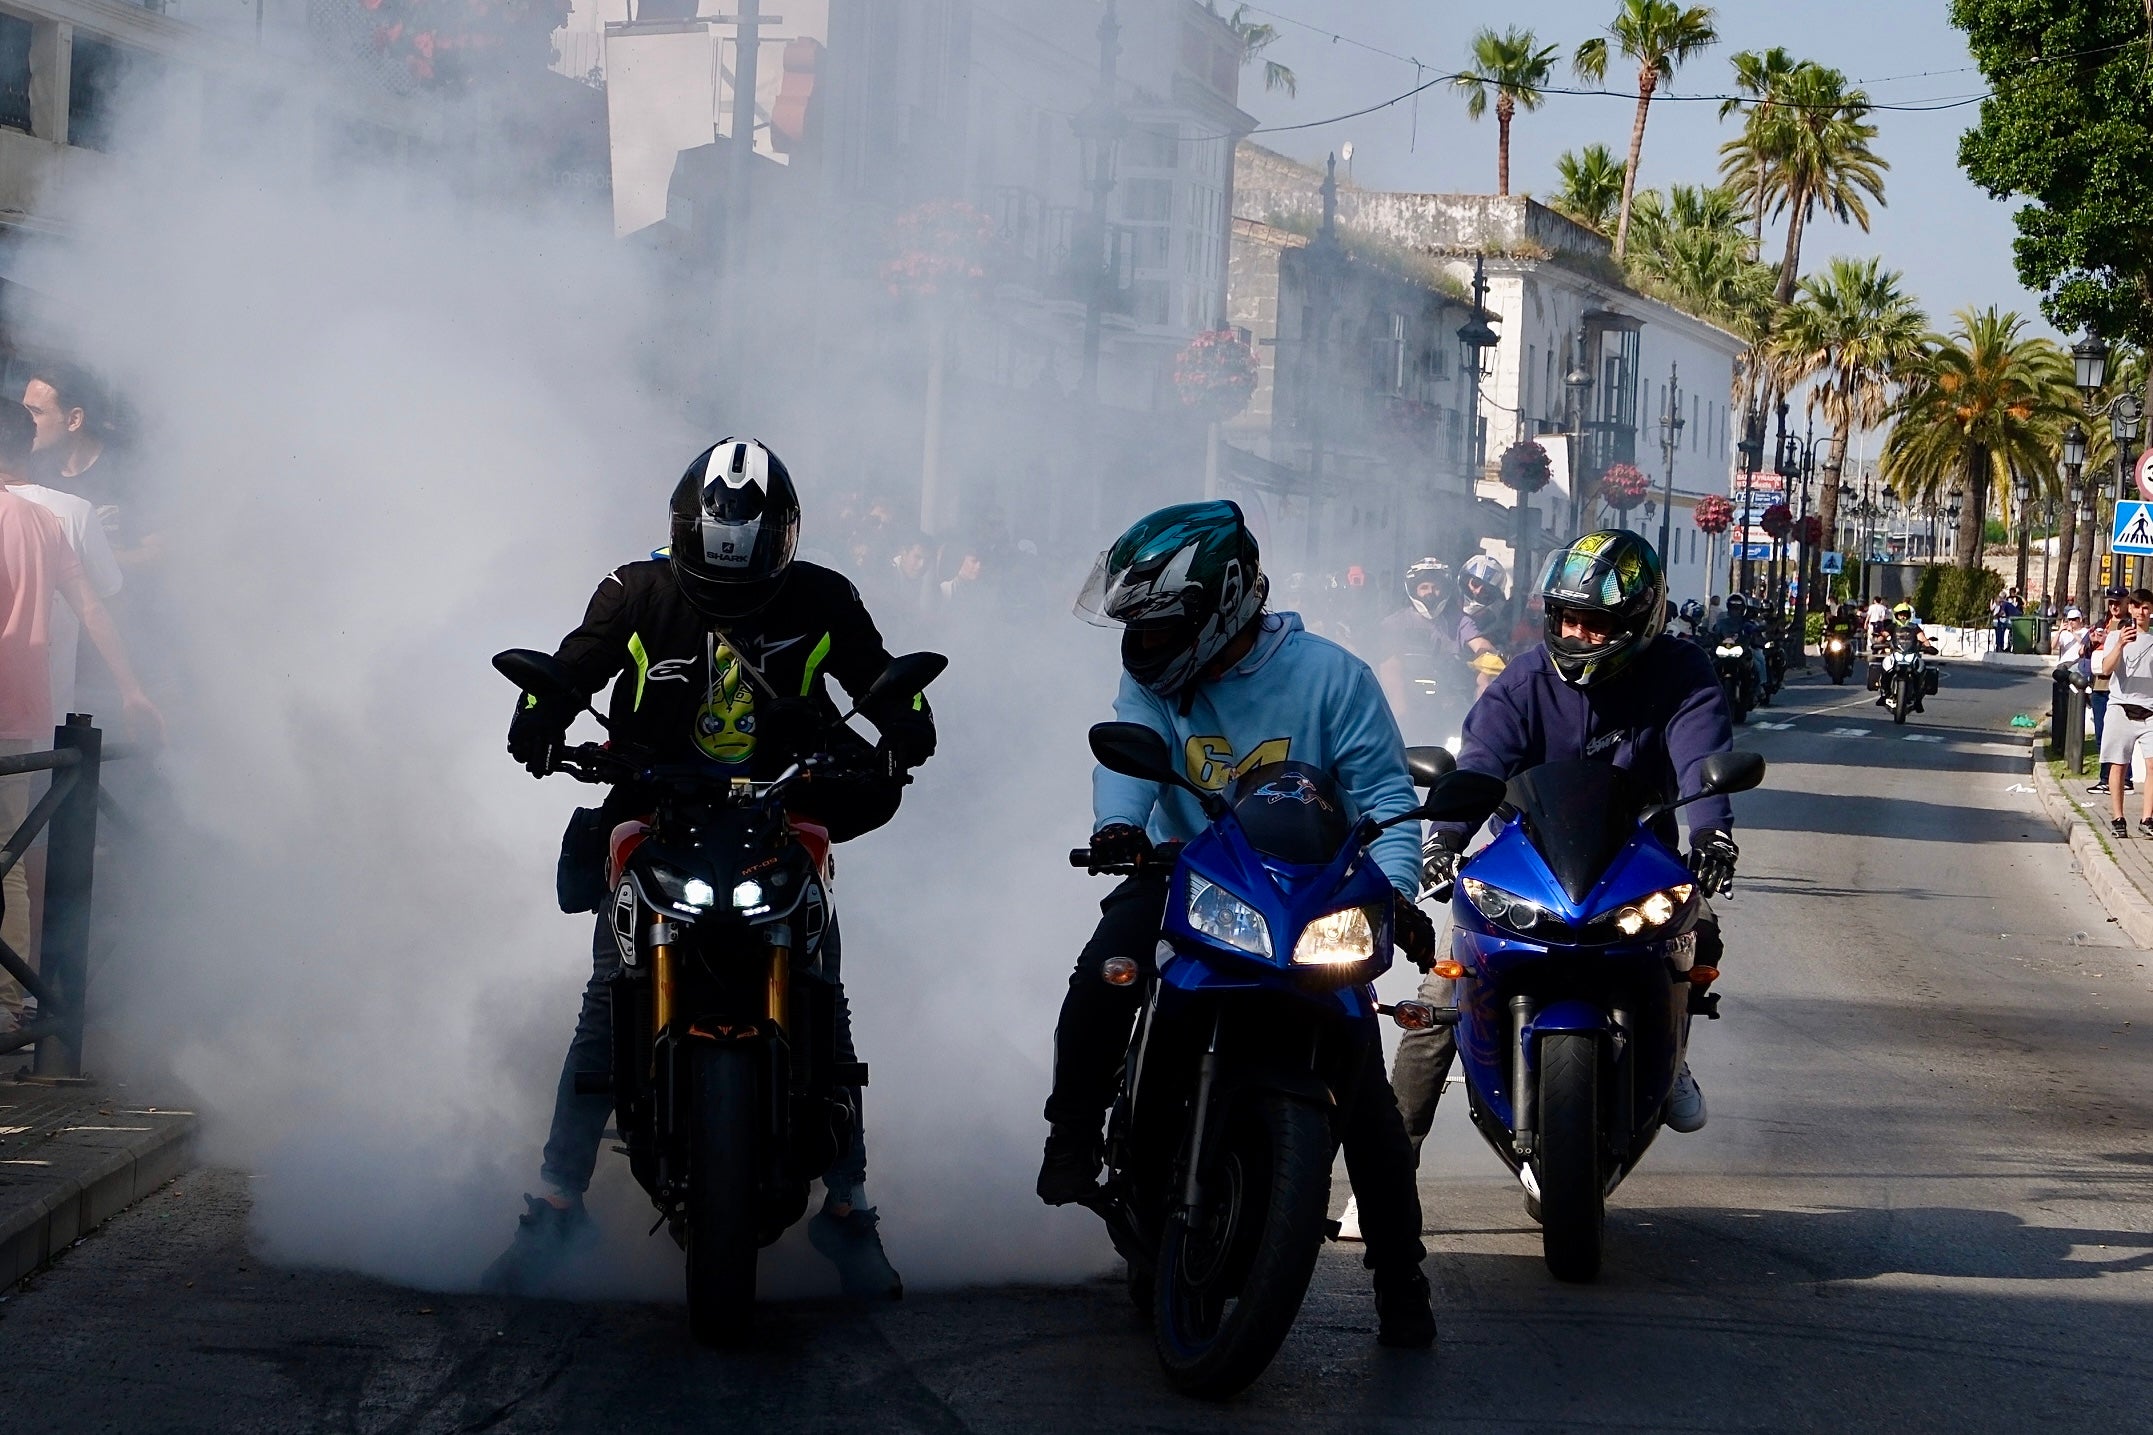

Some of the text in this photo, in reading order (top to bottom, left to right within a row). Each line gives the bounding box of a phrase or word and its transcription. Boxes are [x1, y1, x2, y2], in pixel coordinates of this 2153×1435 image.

[553, 170, 583, 187] LOS
[706, 551, 748, 562] SHARK
[1185, 735, 1292, 791] 64
[741, 857, 778, 876] MT-09
